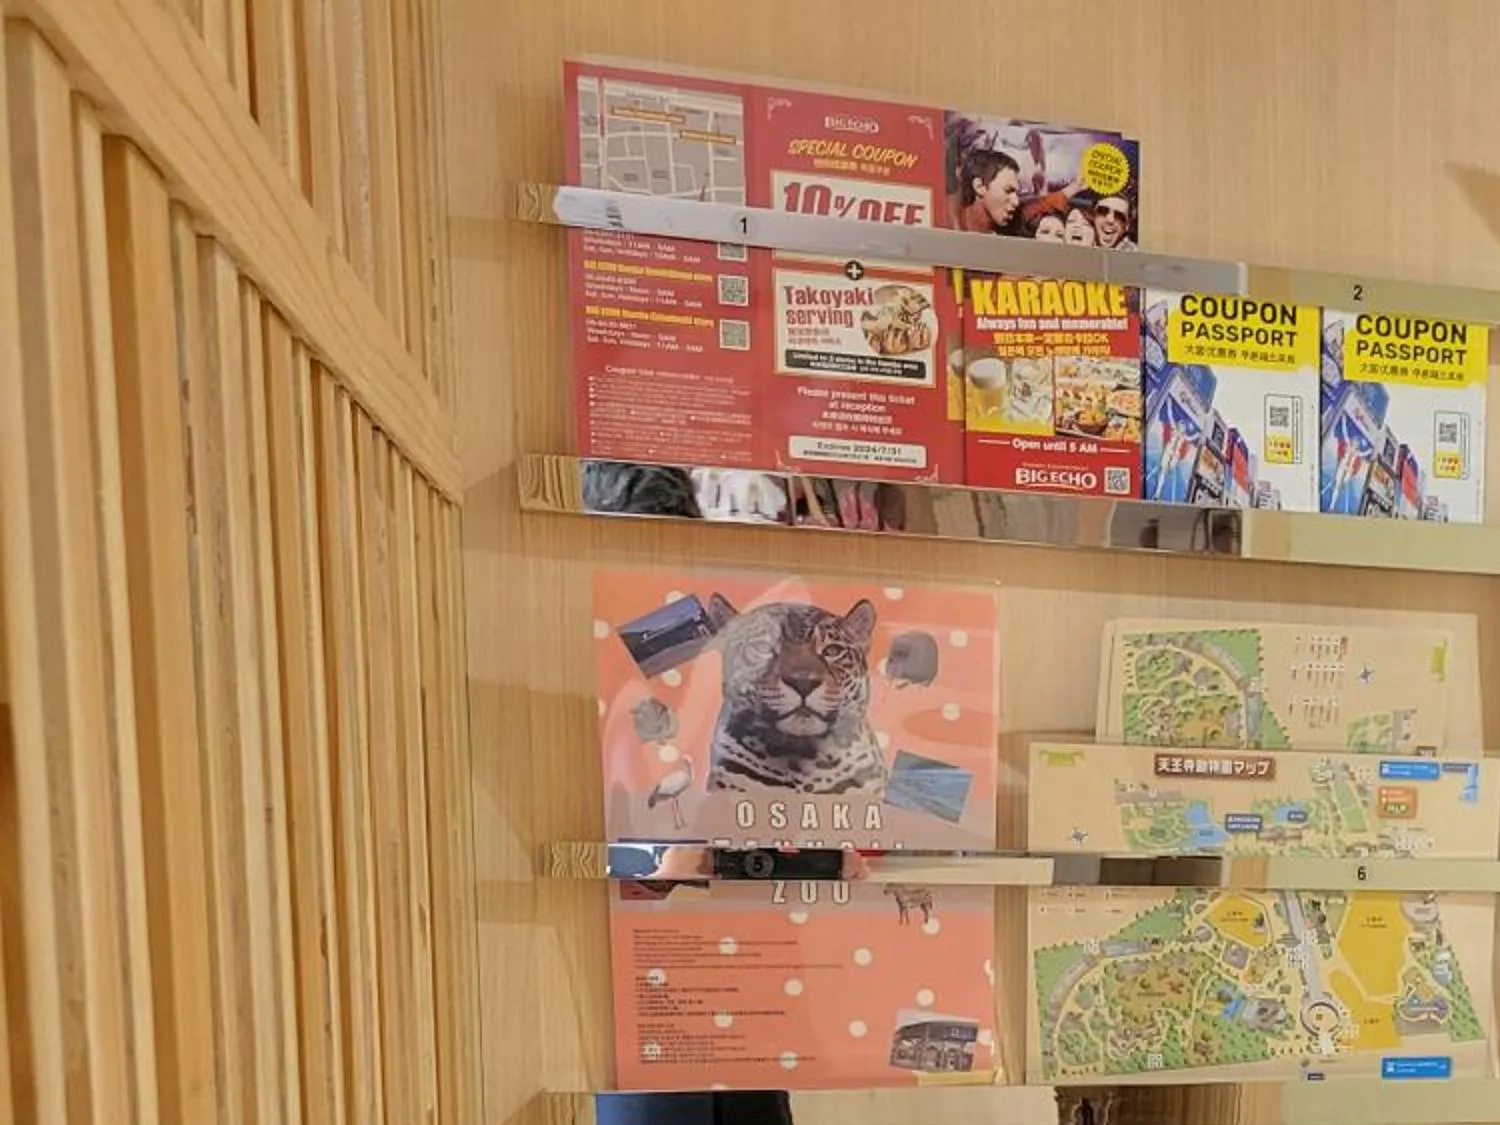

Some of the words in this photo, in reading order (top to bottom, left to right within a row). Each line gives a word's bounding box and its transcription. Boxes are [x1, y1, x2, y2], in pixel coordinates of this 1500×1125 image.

[788, 139, 848, 157] SPECIAL
[852, 146, 918, 168] COUPON
[739, 217, 747, 234] 1
[784, 286, 873, 308] Takoyaki
[971, 278, 1128, 317] KARAOKE
[1353, 285, 1363, 301] 2
[786, 308, 854, 328] serving
[1181, 295, 1297, 326] COUPON
[1181, 321, 1297, 348] PASSPORT
[1356, 314, 1467, 345] COUPON
[1356, 340, 1467, 366] PASSPORT
[1012, 438, 1041, 450] Open
[1044, 439, 1068, 451] until
[1080, 442, 1098, 453] AM
[1015, 468, 1049, 486] BIG
[1050, 470, 1098, 489] ECHO
[735, 799, 884, 831] OSAKA
[1357, 865, 1367, 882] 6
[771, 880, 850, 905] ZOO
